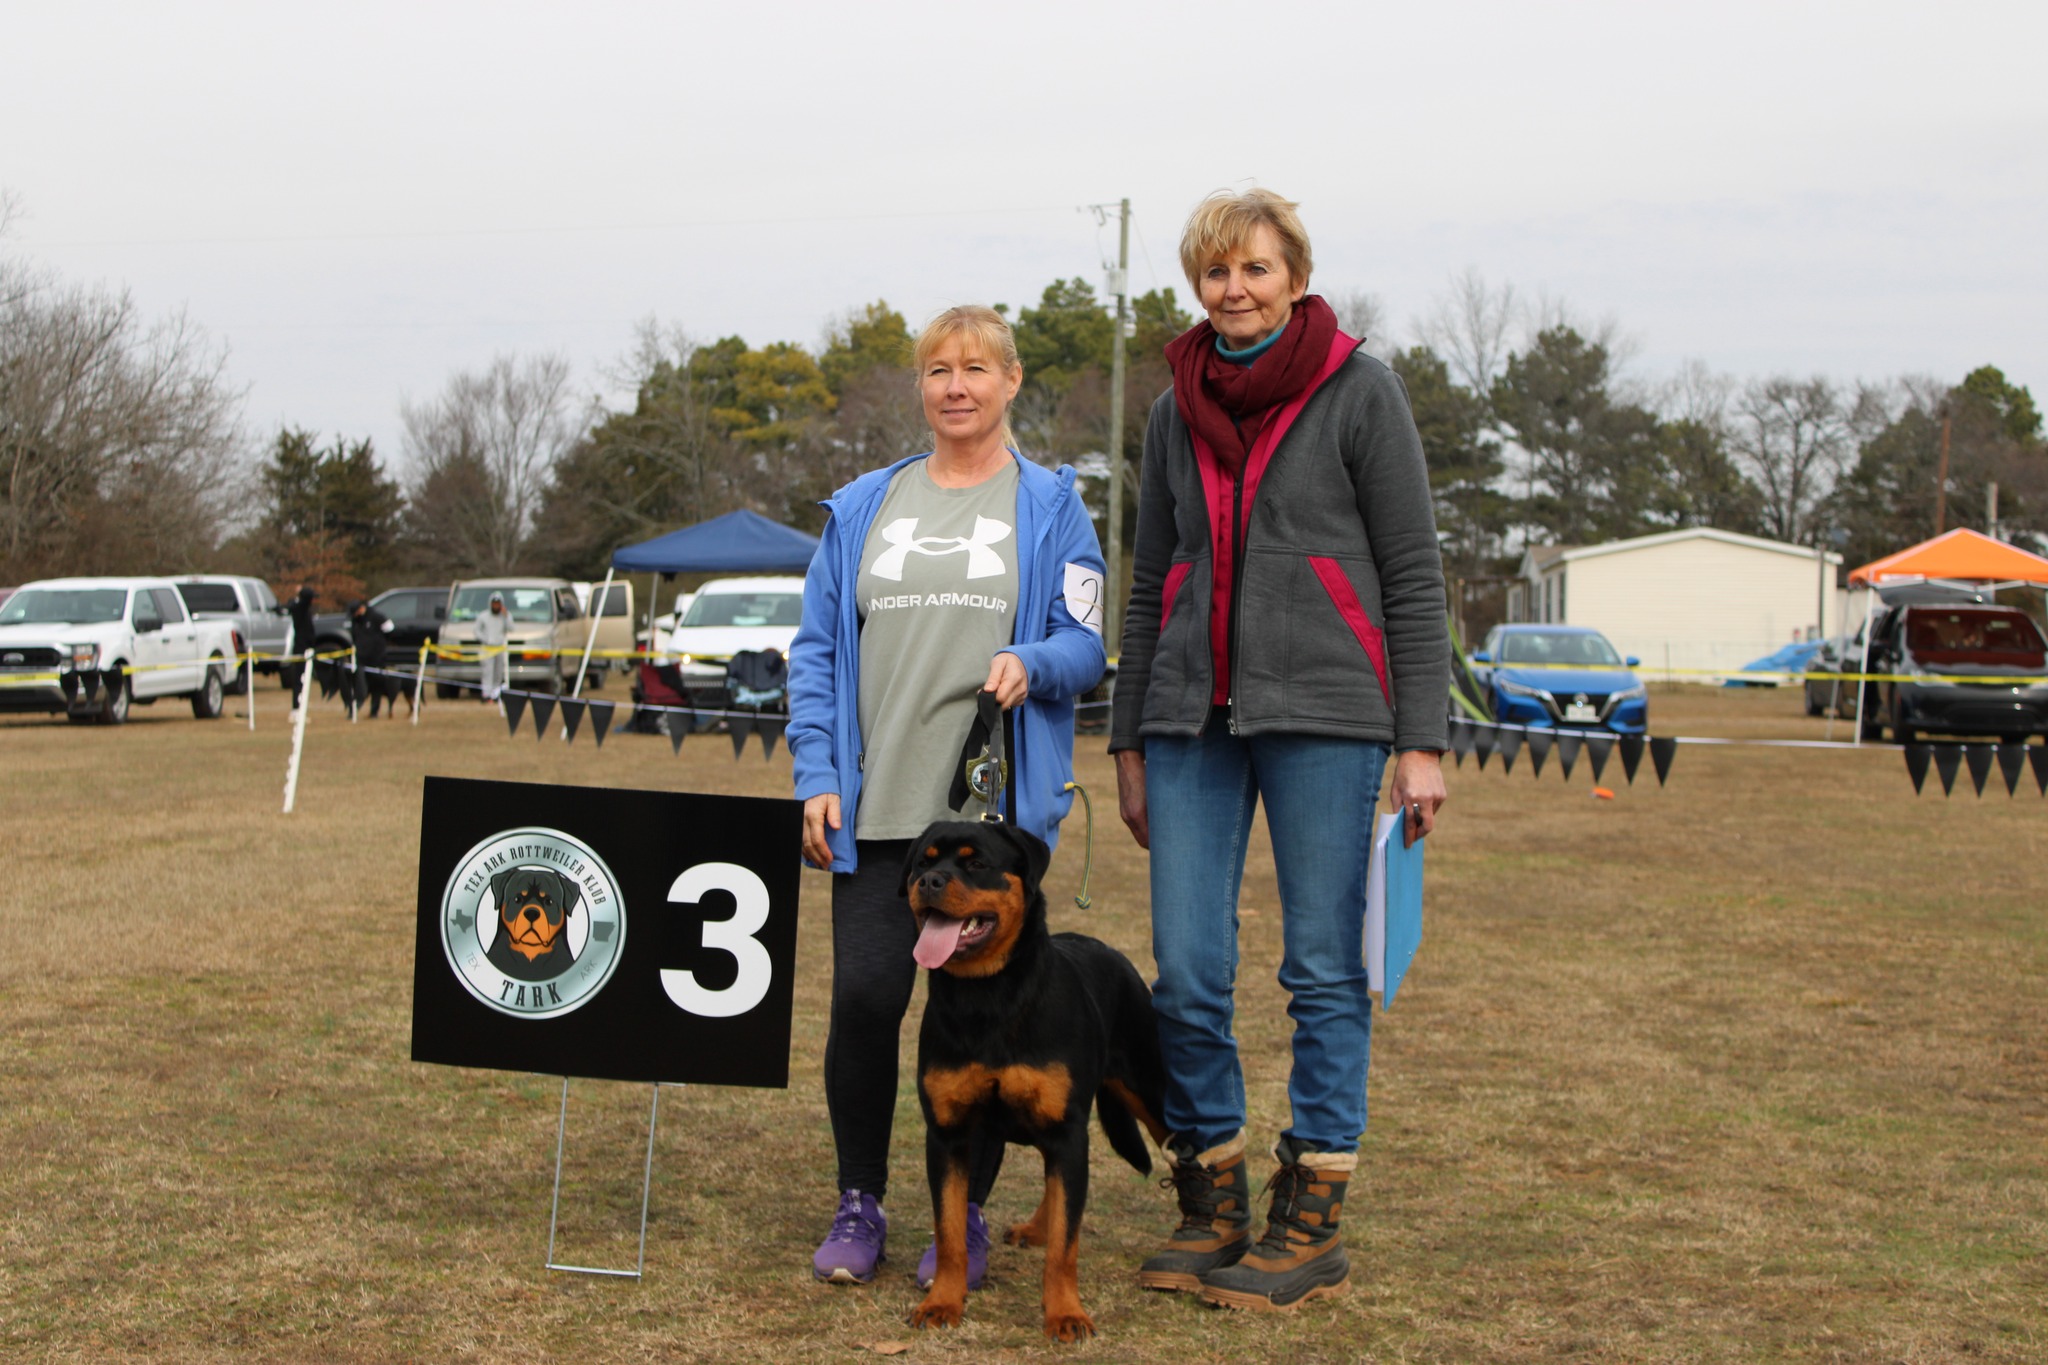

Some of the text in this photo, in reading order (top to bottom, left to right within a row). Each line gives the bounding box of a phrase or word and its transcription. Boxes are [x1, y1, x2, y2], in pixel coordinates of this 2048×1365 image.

[925, 593, 1007, 613] ARMOUR
[464, 845, 607, 905] TEX ARK ROTTWEILER KLUB
[660, 862, 772, 1017] 3
[465, 952, 481, 970] TEX
[580, 960, 598, 981] ARK
[500, 979, 562, 1007] TARK
